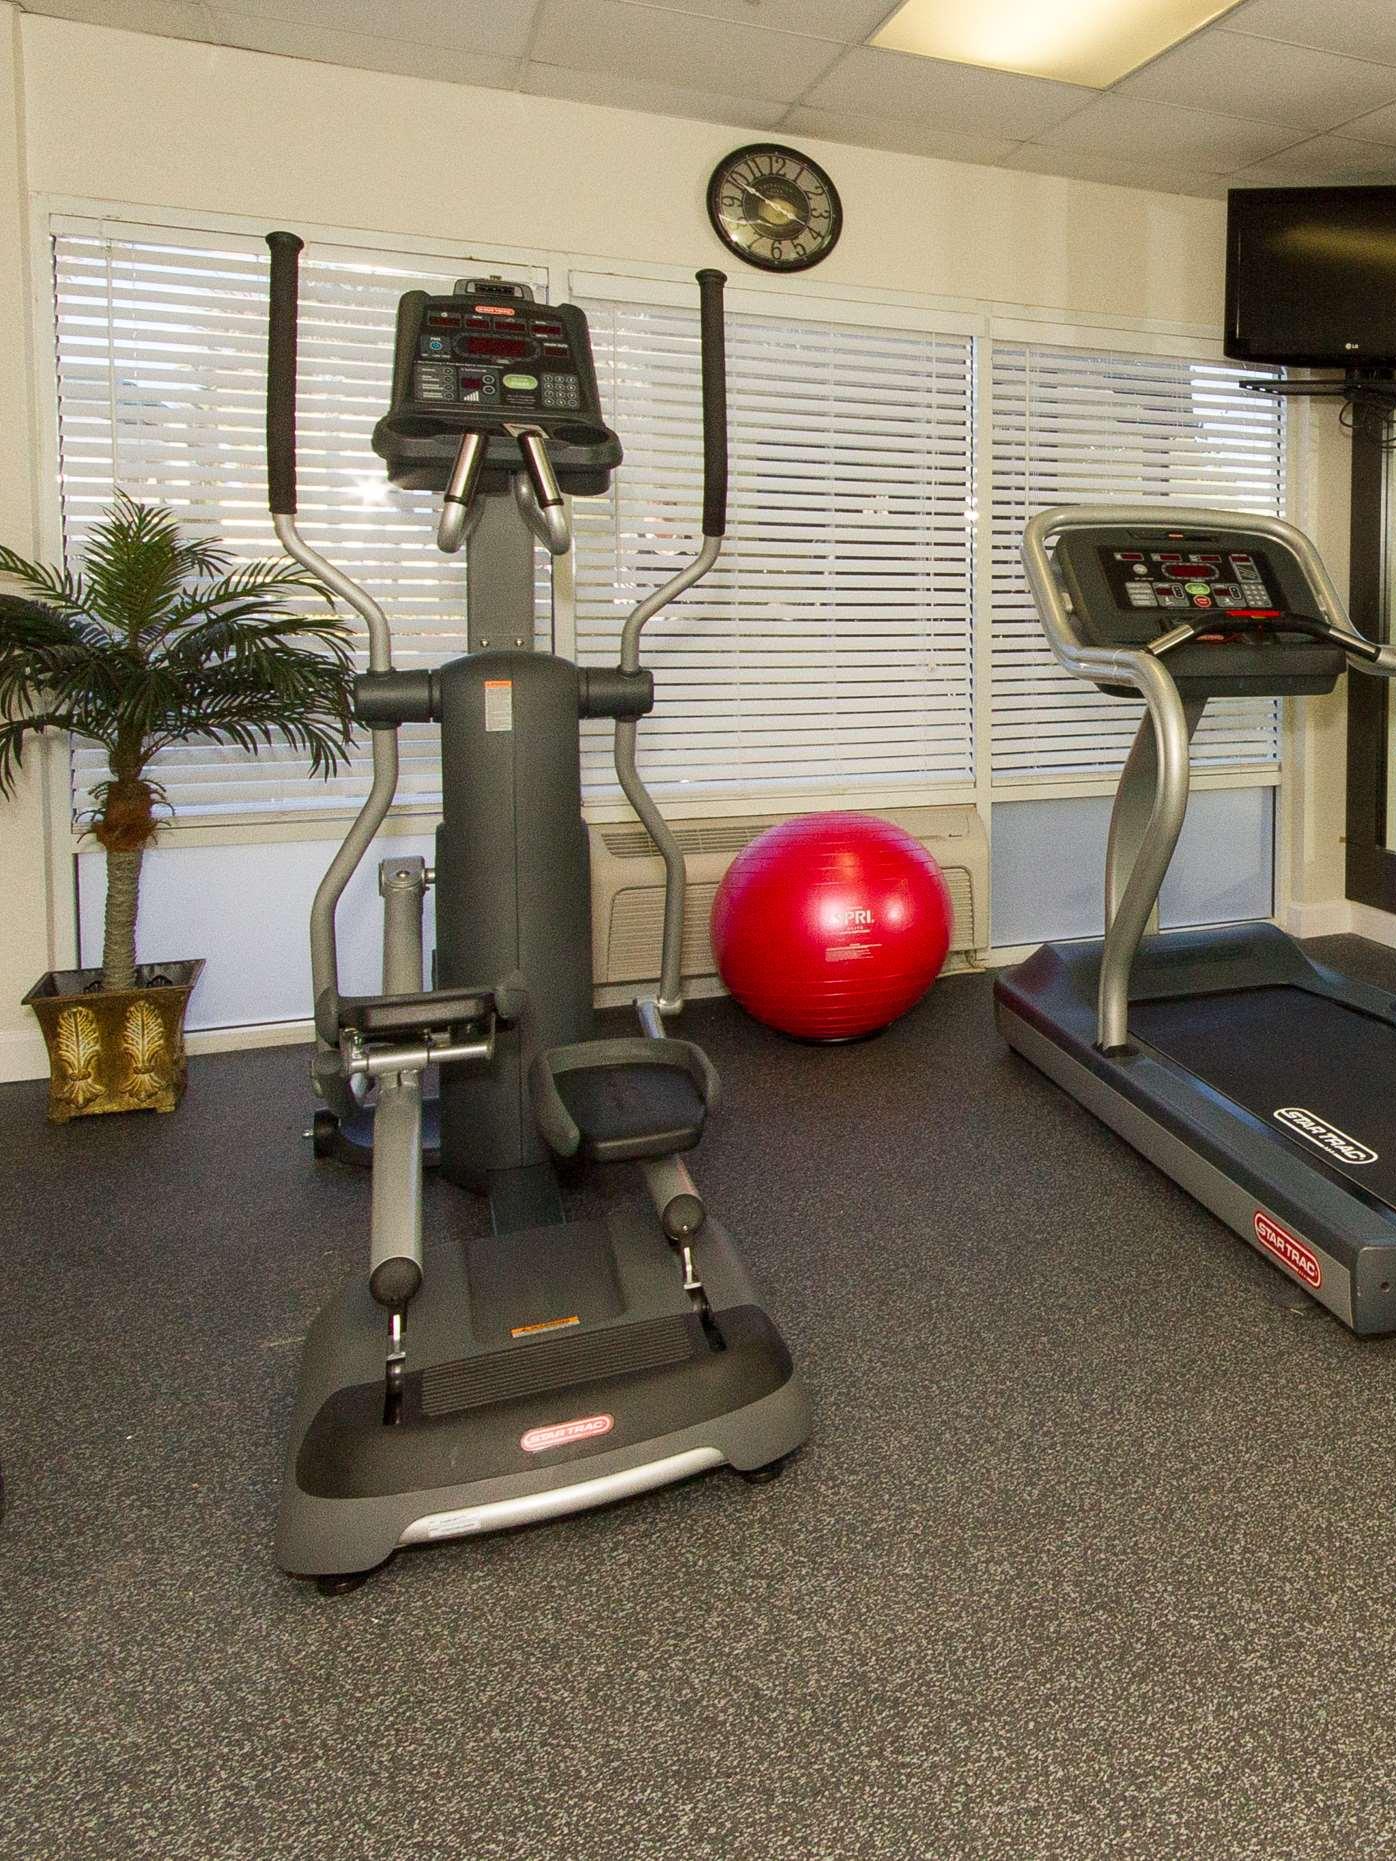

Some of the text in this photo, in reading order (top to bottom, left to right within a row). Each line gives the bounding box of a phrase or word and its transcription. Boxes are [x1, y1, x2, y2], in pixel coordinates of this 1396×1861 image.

[767, 155, 787, 177] 12
[804, 185, 825, 200] 2
[811, 207, 831, 220] 3
[771, 240, 783, 260] 6
[790, 239, 807, 257] 5
[1283, 1111, 1366, 1159] STAR TRAC
[1257, 1222, 1316, 1276] STAR TRAC
[530, 1420, 604, 1442] STAR TRAC
